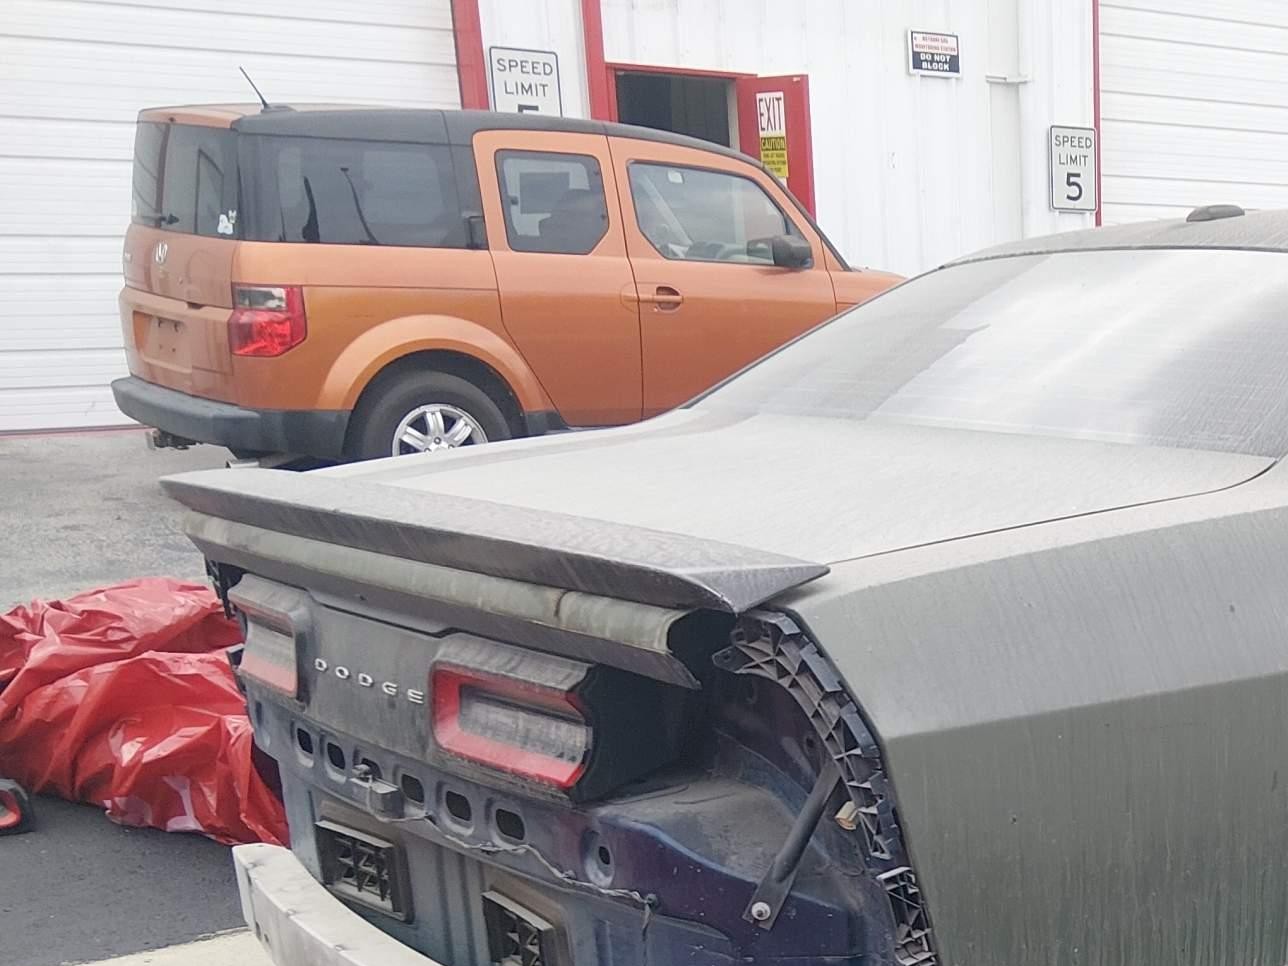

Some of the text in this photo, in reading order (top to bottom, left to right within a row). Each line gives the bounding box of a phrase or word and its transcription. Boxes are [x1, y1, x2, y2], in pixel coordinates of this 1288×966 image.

[934, 54, 951, 62] NOT
[497, 58, 553, 76] SPEED
[921, 61, 950, 71] BLOCK
[504, 80, 549, 97] LIMIT
[758, 97, 782, 131] EXIT
[761, 138, 785, 150] CAUTION
[1054, 135, 1093, 149] SPEED
[1059, 153, 1088, 167] LIMIT
[1066, 172, 1083, 202] 5
[314, 658, 424, 704] DODGE
